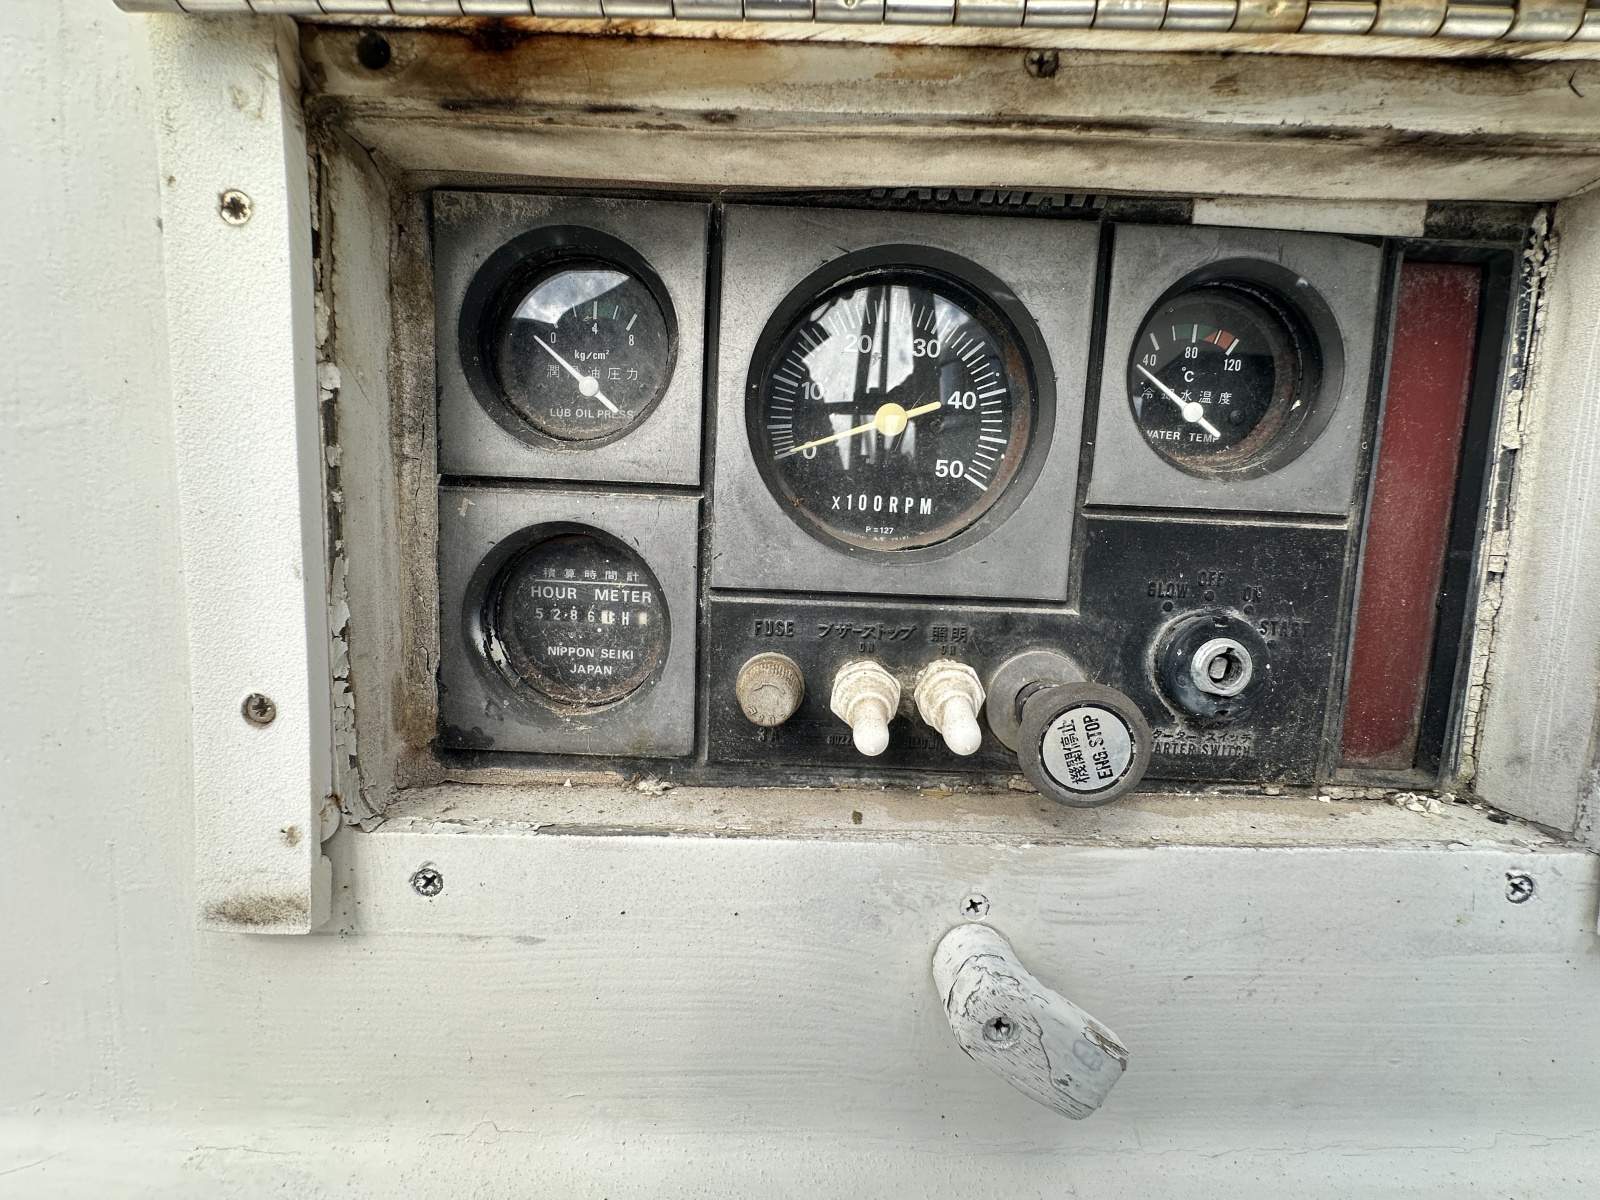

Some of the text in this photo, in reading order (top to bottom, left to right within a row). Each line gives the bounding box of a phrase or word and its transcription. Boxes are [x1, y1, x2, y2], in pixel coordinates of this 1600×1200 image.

[591, 322, 599, 335] 4
[550, 331, 557, 344] 0
[628, 334, 635, 347] 8
[843, 333, 873, 354] 20
[912, 338, 941, 358] 30
[1184, 346, 1199, 359] 80
[1142, 353, 1157, 367] 40
[1223, 358, 1242, 372] 120
[801, 381, 825, 401] 10
[947, 391, 977, 410] 40
[550, 408, 572, 418] LUB
[575, 408, 595, 419] OIL
[802, 441, 818, 460] 0
[935, 460, 964, 479] 50
[543, 567, 640, 582] 積算時間計
[1197, 569, 1226, 588] OFF
[530, 586, 652, 603] HOUR METER
[1147, 581, 1188, 599] GLOW
[1243, 586, 1263, 602] ON
[754, 618, 795, 638] FUSE
[817, 622, 917, 641] ブザーストップ
[931, 624, 969, 643] 照明
[1259, 618, 1311, 638] START
[547, 646, 634, 660] NIPPON SEIKI
[858, 641, 875, 653] ON
[569, 664, 612, 676] JAPAN
[1151, 741, 1250, 758] ARTER SWITCH
